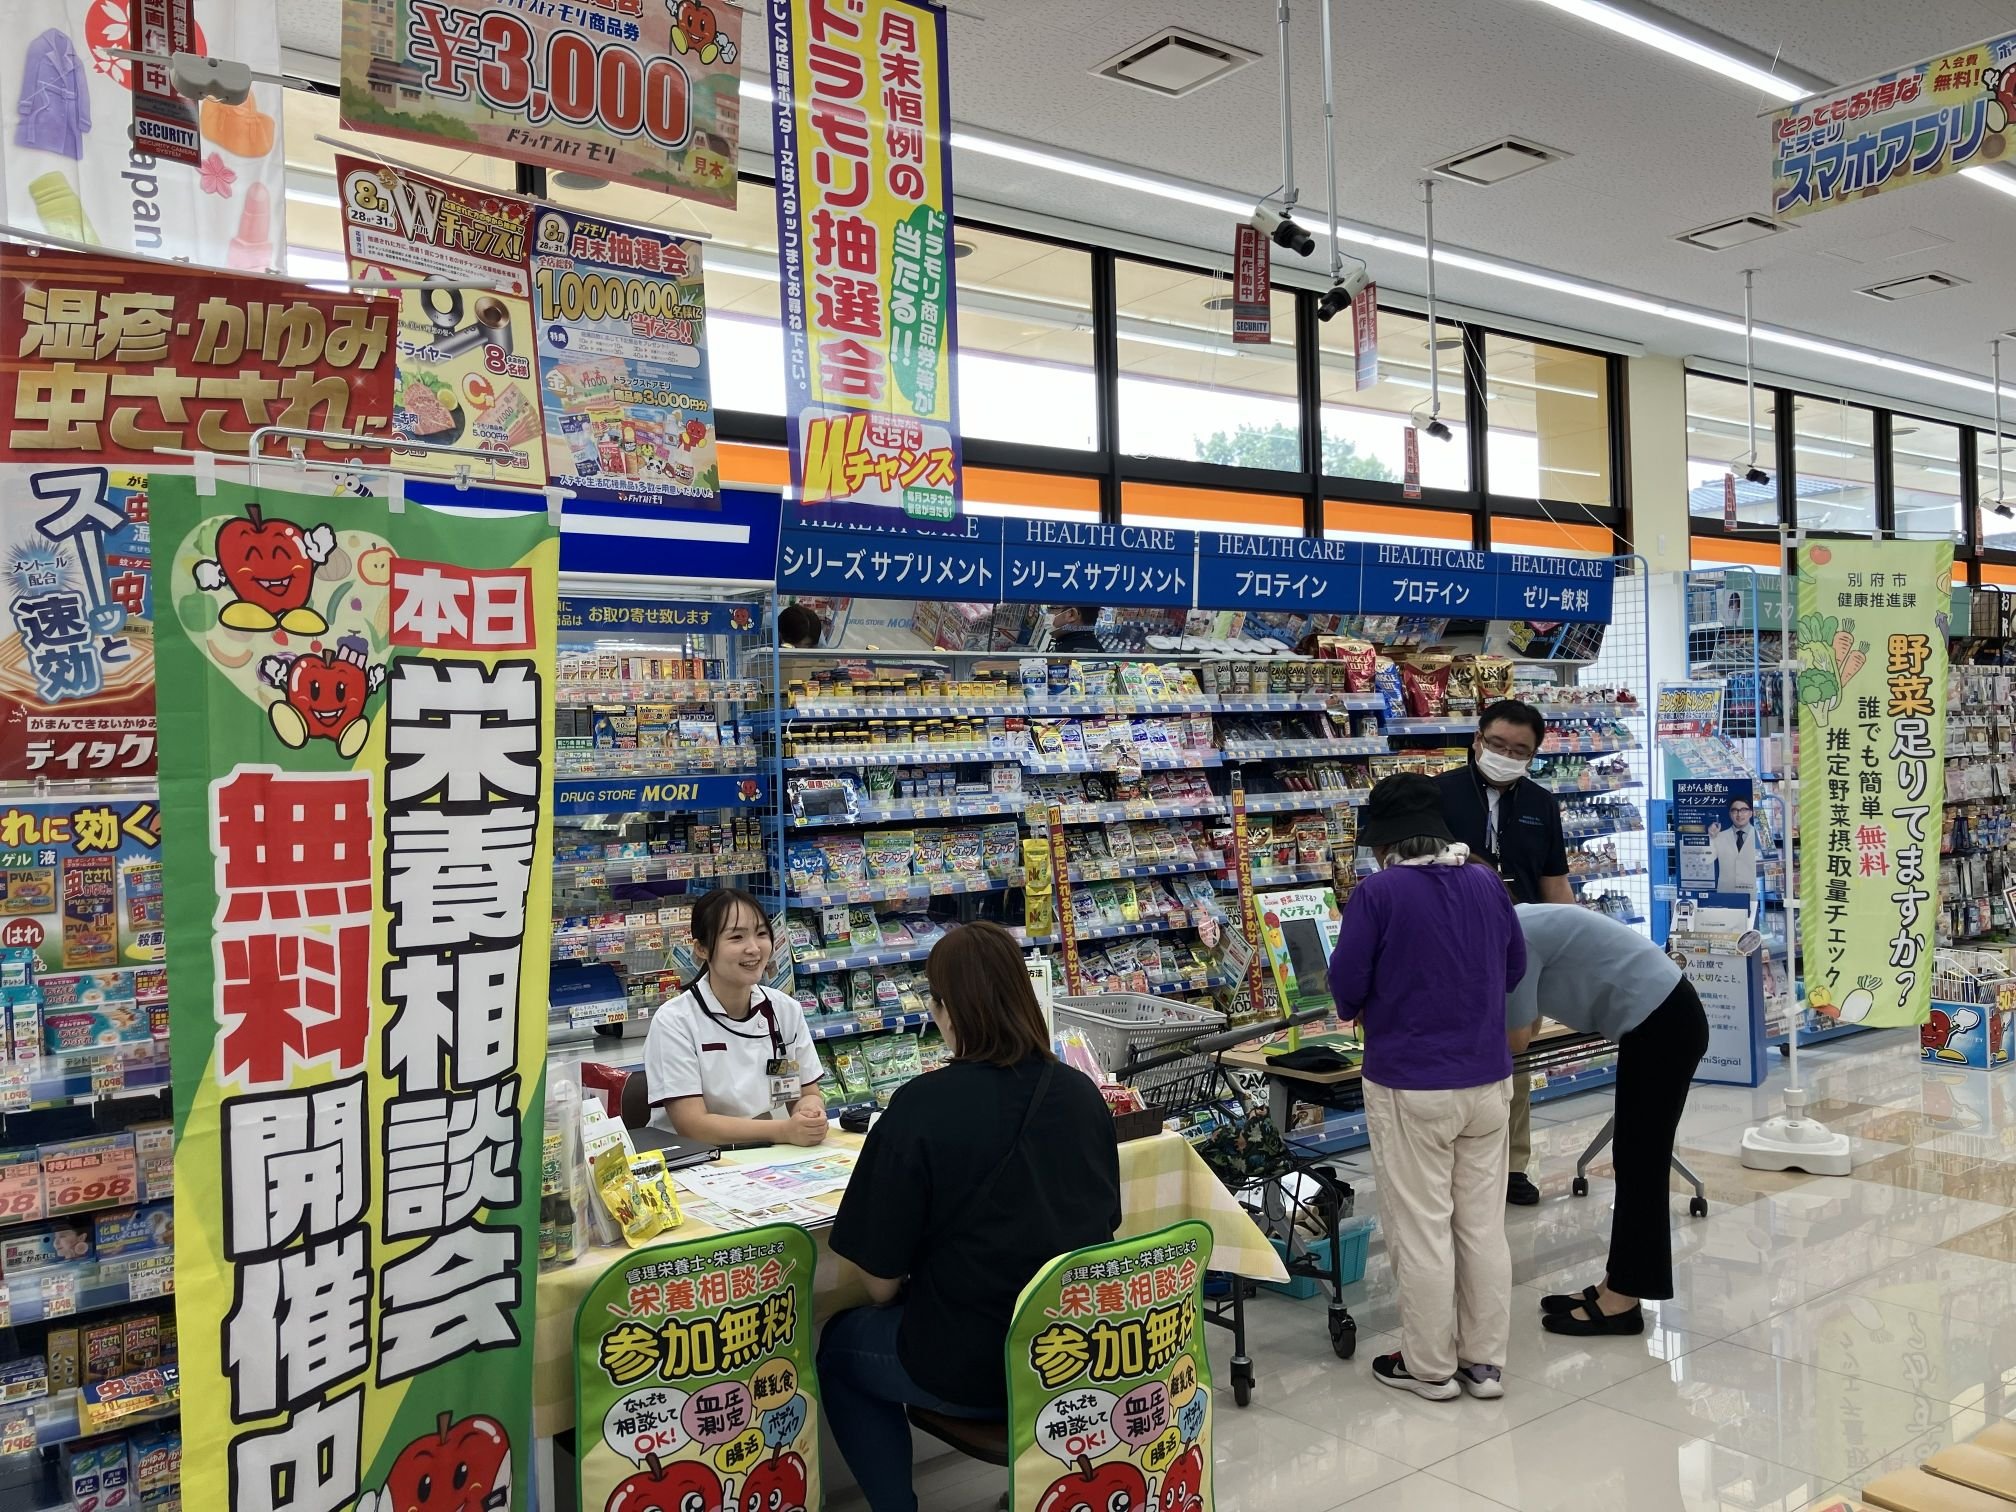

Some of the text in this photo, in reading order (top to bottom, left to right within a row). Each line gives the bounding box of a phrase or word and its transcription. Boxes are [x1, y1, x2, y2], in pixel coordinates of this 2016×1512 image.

[409, 2, 693, 148] ¥3,000
[1939, 53, 1979, 72] 入会費
[1932, 68, 1982, 92] 無料!
[879, 11, 925, 201] 月末恒例の
[1778, 73, 1924, 139] とってもお得な
[139, 120, 194, 147] SECURITY
[1780, 122, 1844, 158] ドラモリ
[694, 156, 724, 180] 見本
[1775, 97, 1988, 213] スマホアプリ
[354, 179, 389, 213] 8月
[808, 0, 885, 400] ドラモリ抽選会
[544, 219, 565, 243] 8月
[574, 221, 608, 239] ドラモリ
[571, 231, 689, 278] 月末抽選会
[19, 288, 390, 370] 湿疹・かゆみ
[1236, 321, 1268, 332] SECURITY
[613, 376, 671, 390] ドラッグストアモリ
[9, 362, 388, 451] 虫さされに
[871, 426, 920, 450] さらに
[1026, 519, 1176, 552] HEALTH CARE
[1218, 534, 1346, 562] HEALTH CARE
[12, 558, 67, 574] メントール
[30, 466, 131, 664] スーッと
[782, 545, 993, 588] シリーズ サプリメント
[1378, 544, 1486, 571] HEALTH CARE
[1511, 554, 1604, 579] HEALTH CARE
[28, 573, 58, 587] 配合
[1012, 559, 1187, 595] シリーズ サプリメント
[1235, 570, 1328, 599] プロテイン
[1847, 572, 1907, 588] 別府市
[110, 570, 147, 617] 虫
[1392, 577, 1471, 606] プロテイン
[1523, 585, 1590, 613] ゼリー飲料
[1837, 592, 1917, 609] 健康推進課
[393, 567, 529, 646] 本日
[588, 606, 712, 626] お取り寄せ致します
[11, 592, 102, 701] 速効
[30, 717, 157, 731] がまんできないかゆみ
[560, 782, 699, 804] DRUG STORE MORI
[1677, 782, 1729, 794] 尿がん検査は
[1854, 695, 1891, 878] 誰でも簡単 無料
[1678, 796, 1727, 806] マイシグナル
[1886, 633, 1936, 1008] 野菜足りてますか?
[1, 852, 32, 868] ゲル
[39, 850, 57, 867] 液
[1823, 726, 1852, 989] 推定野菜摂取量チェック
[9, 871, 35, 884] PVA
[1280, 904, 1323, 918] ベジチェック
[6, 925, 42, 945] はれ
[65, 923, 90, 934] PVA
[377, 660, 541, 1386] 栄養相談会
[216, 768, 374, 1512] 無料開催中
[47, 1155, 100, 1172] 特価品
[57, 1178, 131, 1206] 698
[625, 1241, 785, 1284] 管理栄養士・栄養士による
[1060, 1239, 1198, 1286] 管理栄養士・栄養士による
[630, 1259, 783, 1317] 栄養相談会
[1059, 1258, 1198, 1319] 栄養相談会
[602, 1287, 797, 1384] 参加無料
[1032, 1291, 1198, 1386] 参加無料
[163, 1368, 178, 1381] に
[753, 1367, 796, 1401] 離乳食
[1169, 1364, 1196, 1400] 離乳食
[623, 1391, 668, 1413] なんでも
[695, 1388, 744, 1412] 血圧
[1053, 1394, 1099, 1416] なんでも
[1125, 1389, 1166, 1417] 血圧
[615, 1407, 680, 1438] 相談して
[696, 1410, 746, 1437] 測定
[767, 1406, 796, 1431] ボディ
[777, 1419, 801, 1443] メイク
[1047, 1411, 1110, 1441] 相談して
[1126, 1409, 1167, 1438] 測定
[4, 1436, 32, 1453] 798
[633, 1429, 677, 1455] OK!
[724, 1436, 761, 1467] 腸活
[1065, 1430, 1108, 1456] OK!
[1149, 1433, 1178, 1467] 腸活
